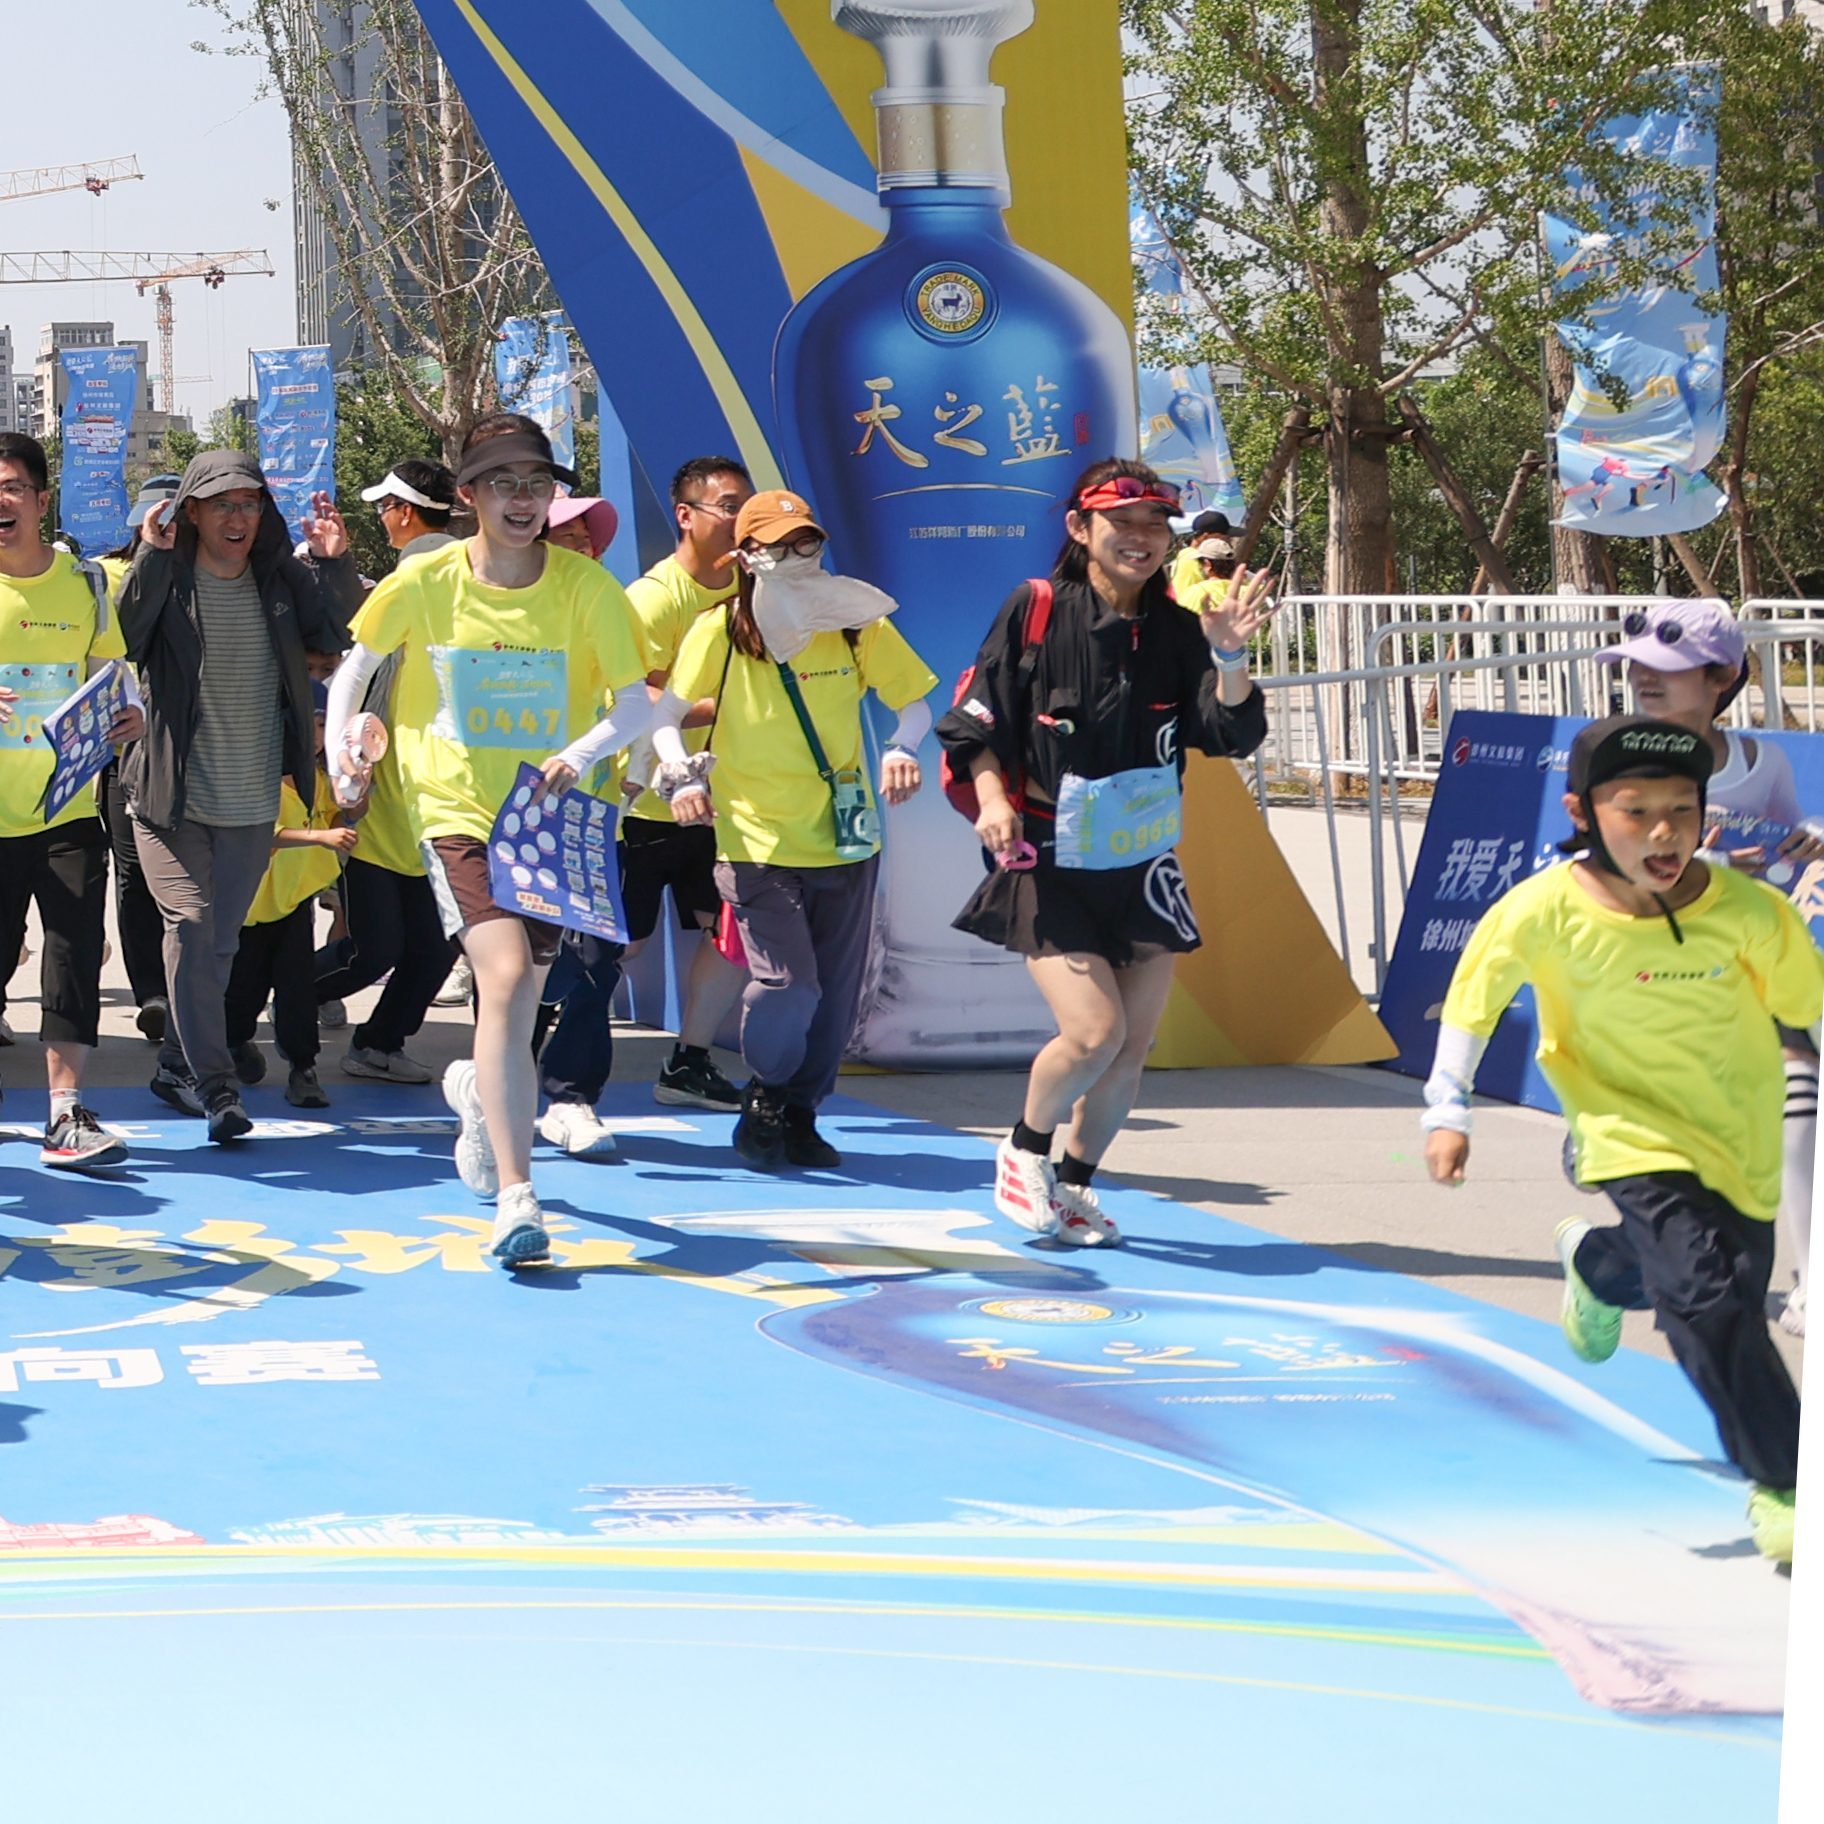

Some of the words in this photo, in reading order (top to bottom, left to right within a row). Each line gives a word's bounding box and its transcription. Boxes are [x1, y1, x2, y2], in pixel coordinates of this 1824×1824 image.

[920, 273, 952, 297] TRADE
[954, 273, 981, 297] MARK
[781, 499, 795, 513] B
[466, 707, 561, 736] 0447
